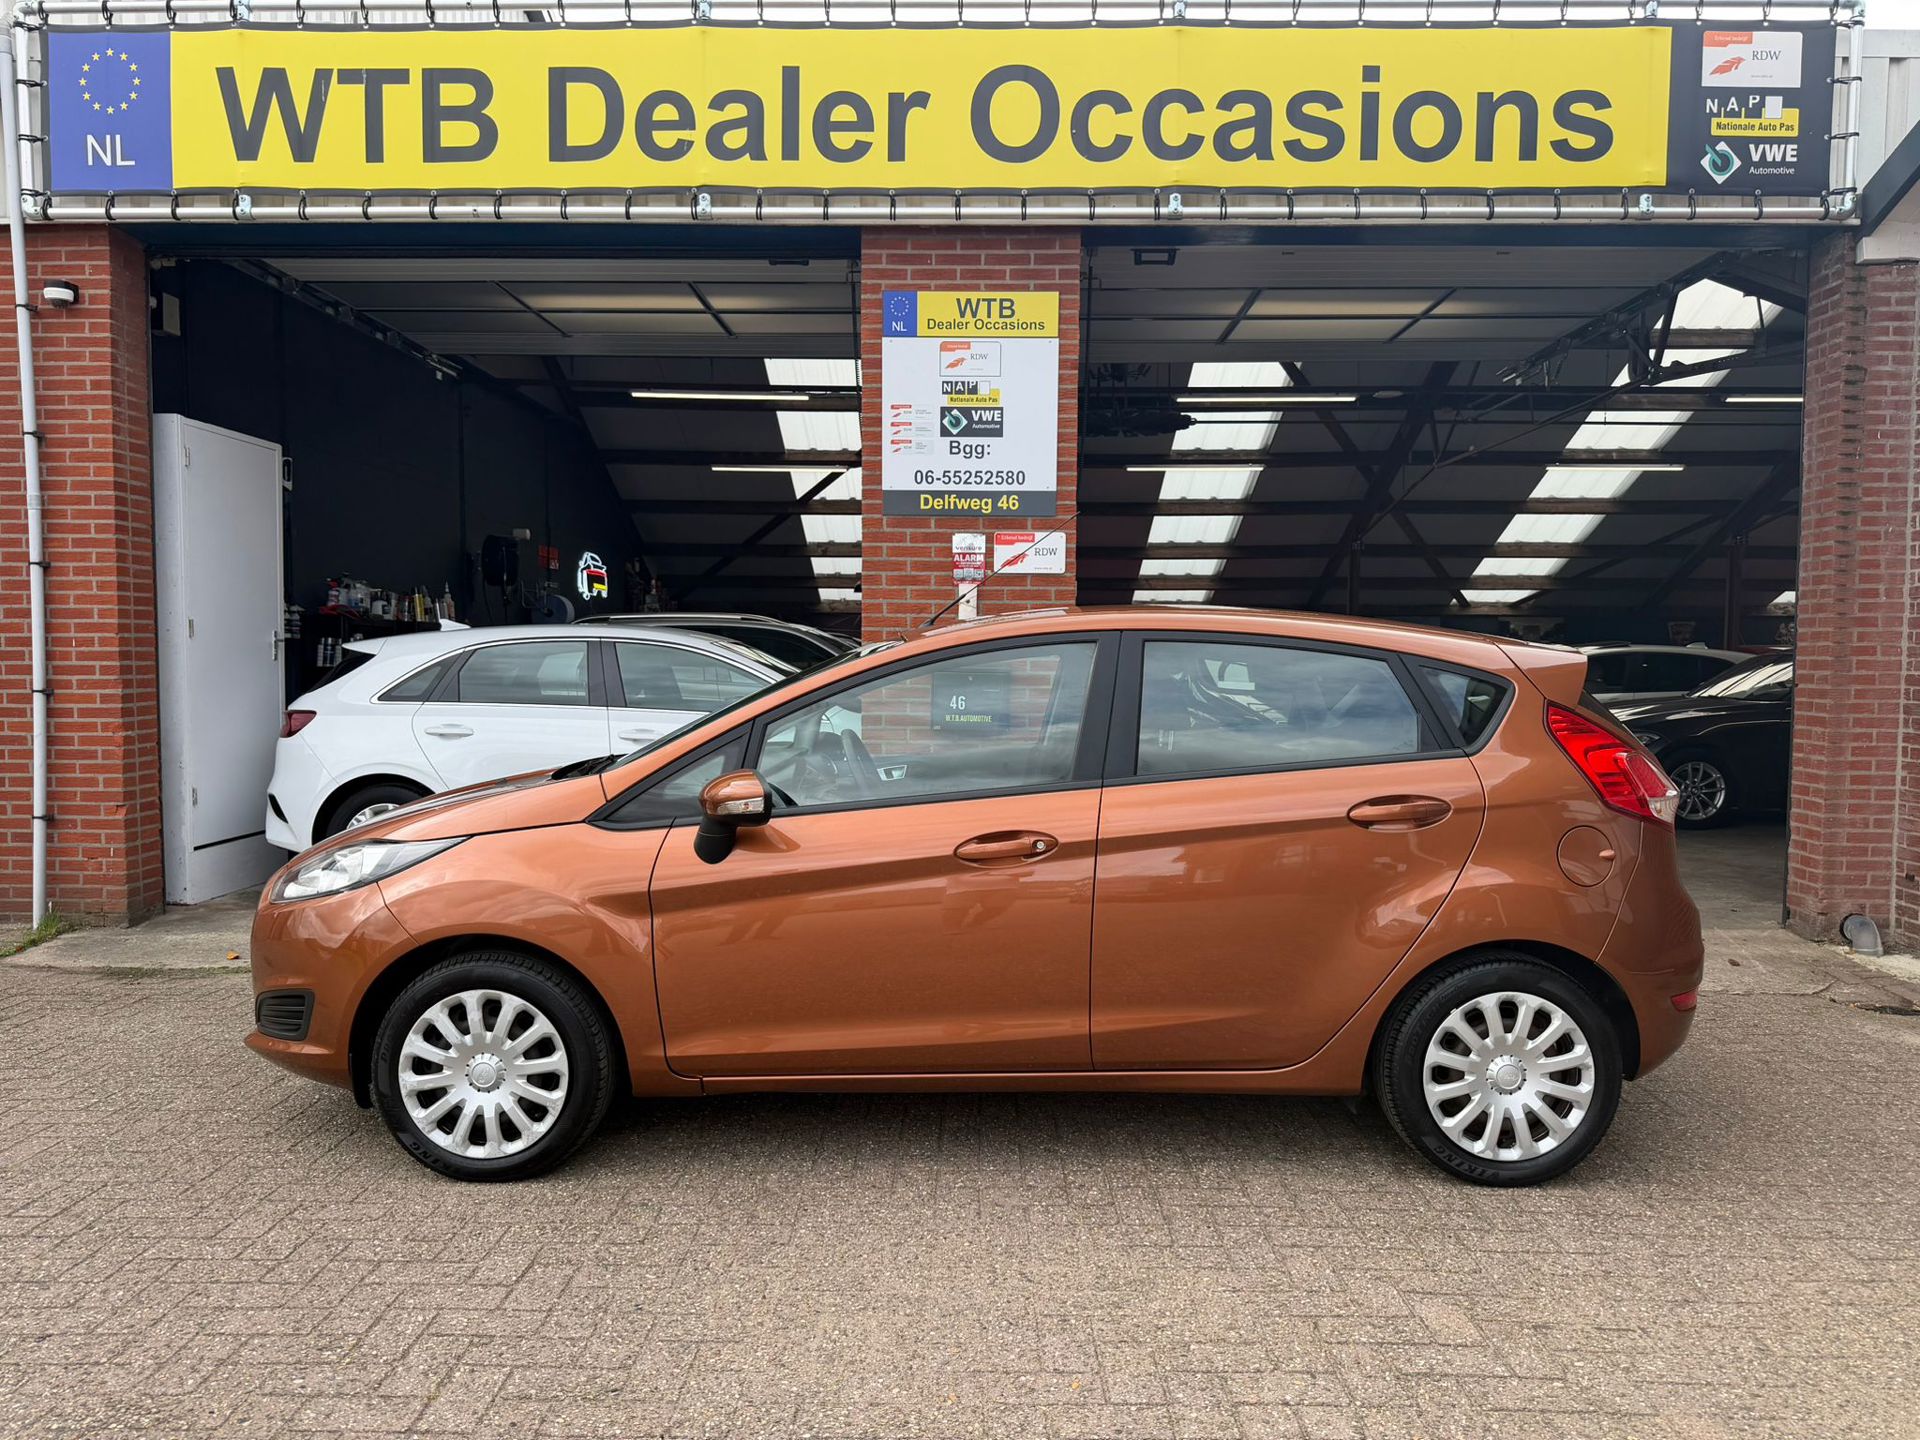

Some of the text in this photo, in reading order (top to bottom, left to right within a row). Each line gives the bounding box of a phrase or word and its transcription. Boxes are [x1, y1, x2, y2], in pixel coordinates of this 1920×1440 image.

[1752, 50, 1781, 61] RDW
[216, 64, 1614, 164] WTB Dealer Occasions
[1716, 121, 1795, 132] Nationale Auto Pas
[86, 134, 136, 166] NL
[1749, 144, 1798, 162] VWE
[1749, 166, 1796, 175] Automotive
[956, 297, 1016, 319] WTB
[892, 321, 907, 332] NL
[927, 319, 1046, 331] Dealer Occasions
[971, 410, 1002, 421] VWE
[949, 440, 991, 459] Bgg:
[914, 470, 1026, 485] 06-55252580
[920, 494, 1019, 514] Delfweg 46
[953, 554, 984, 562] ALARM
[1034, 547, 1058, 556] RDW
[950, 695, 966, 710] 46
